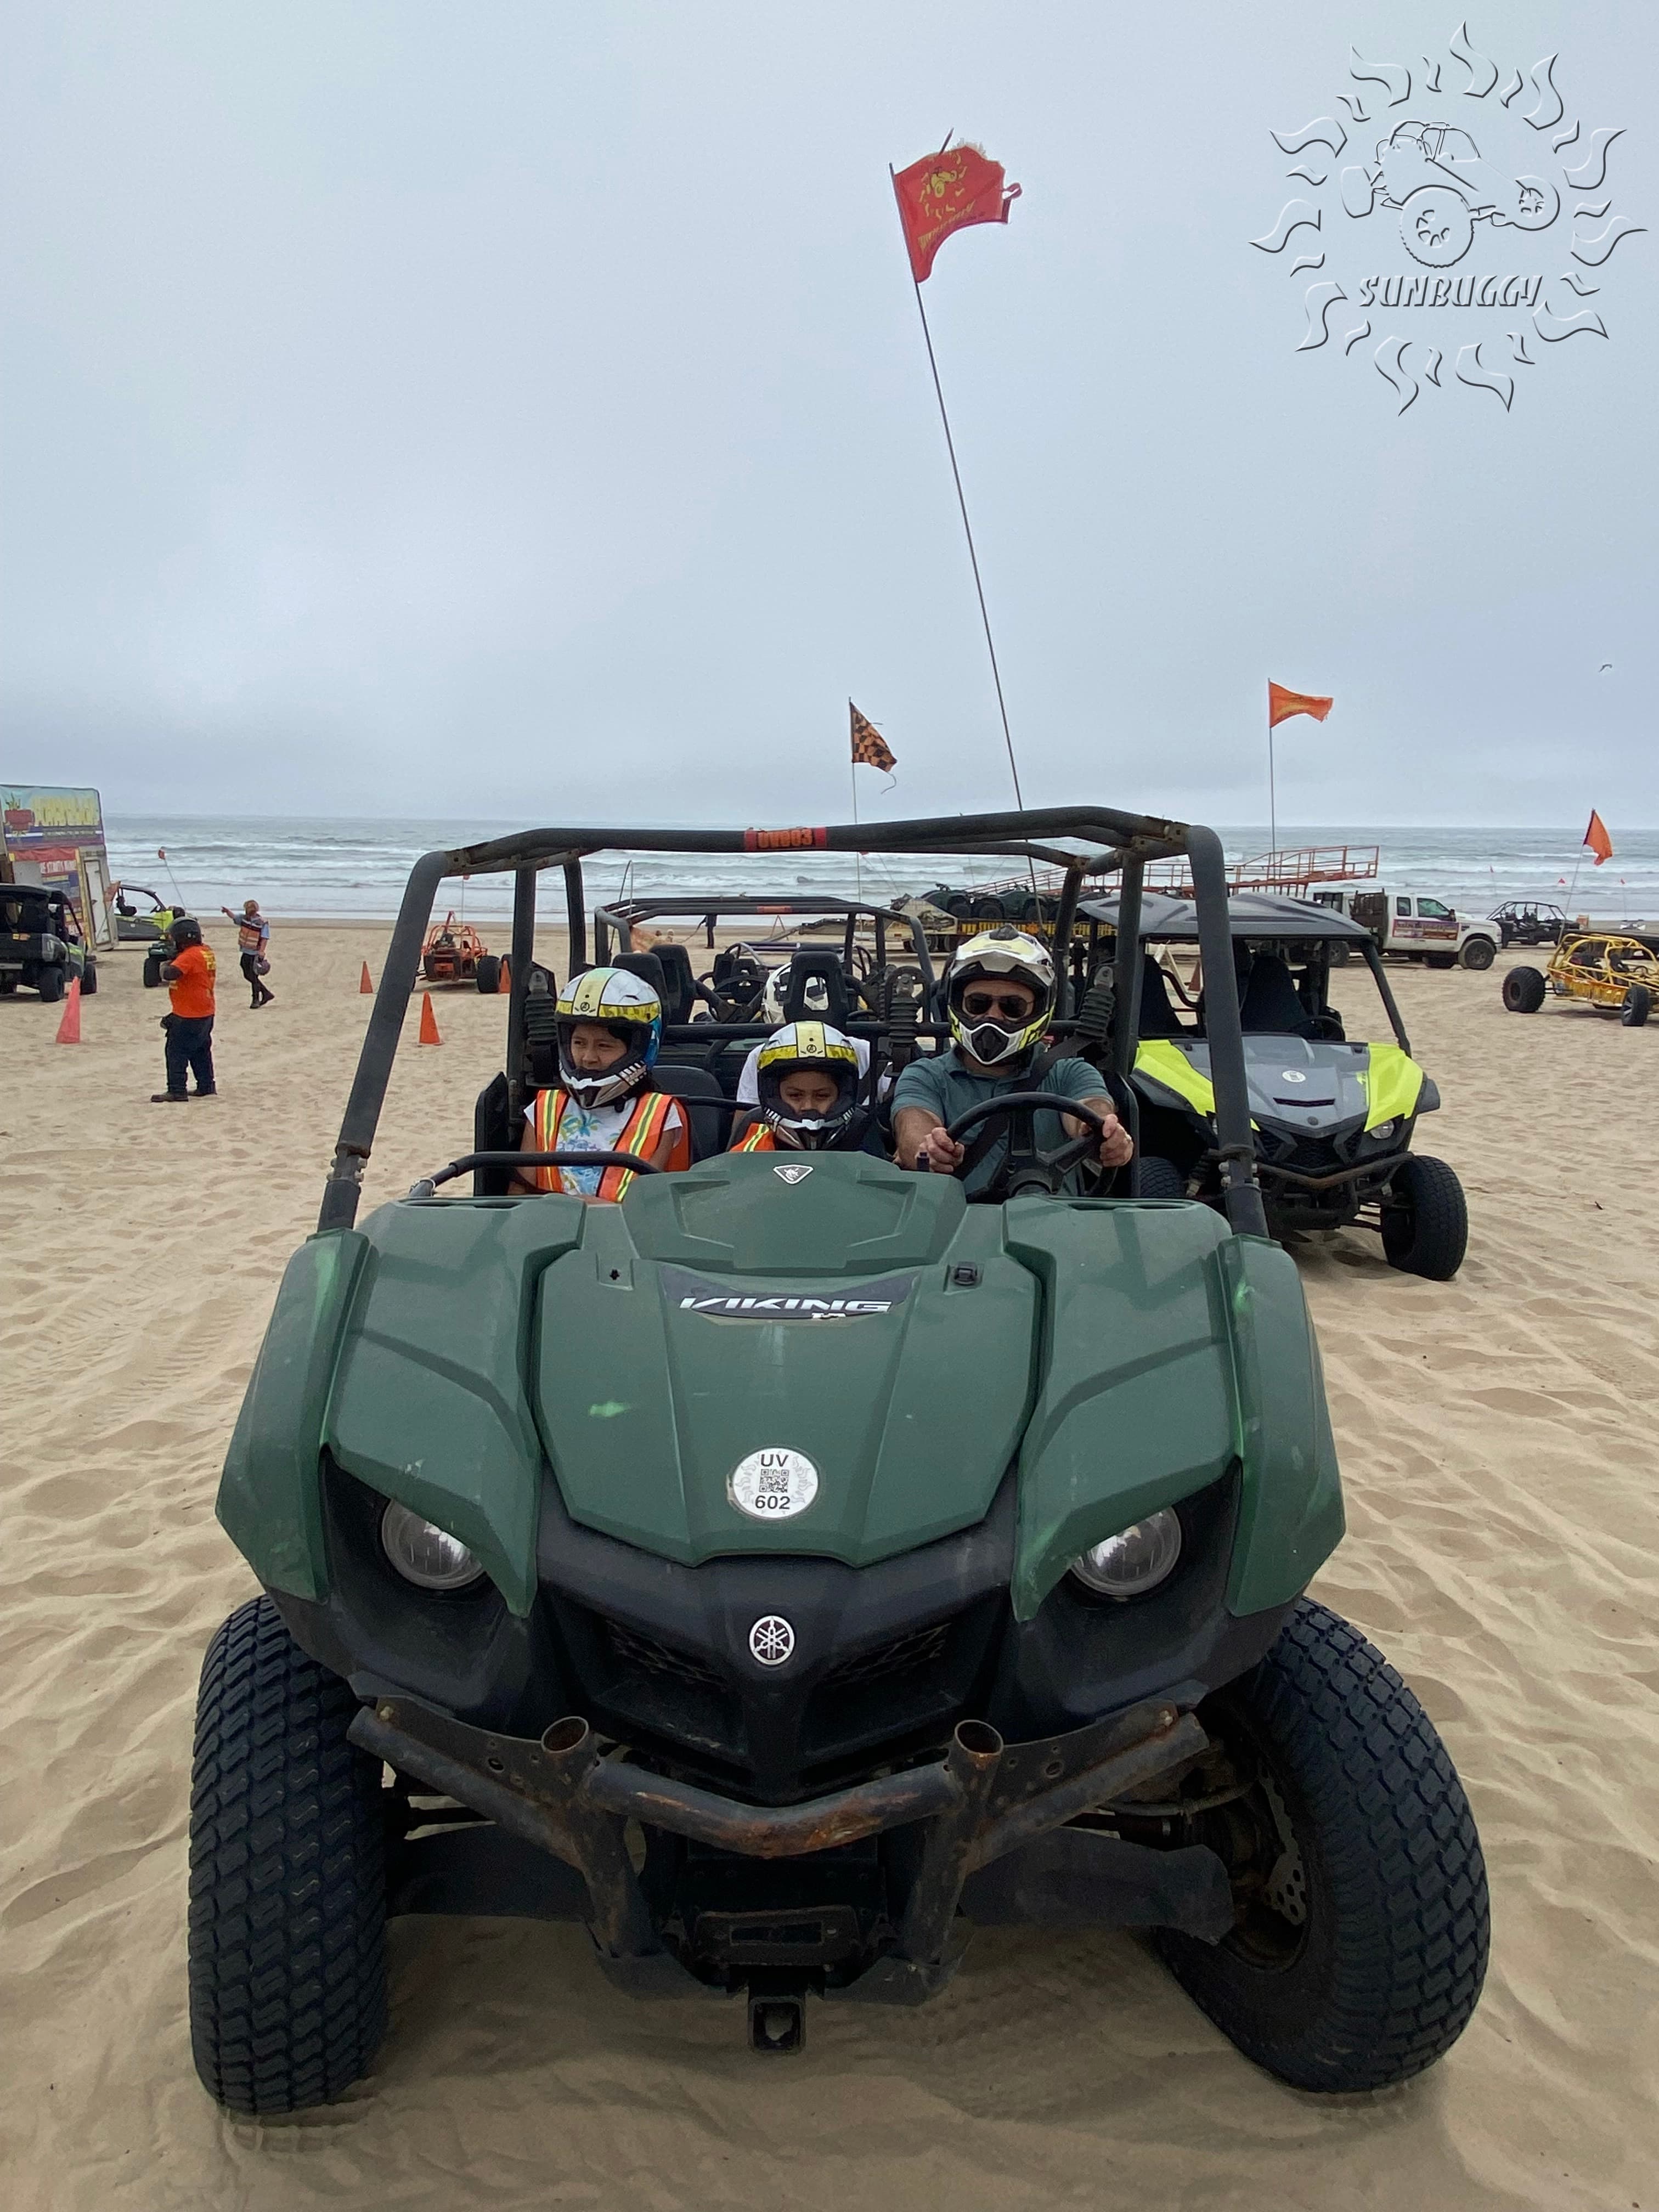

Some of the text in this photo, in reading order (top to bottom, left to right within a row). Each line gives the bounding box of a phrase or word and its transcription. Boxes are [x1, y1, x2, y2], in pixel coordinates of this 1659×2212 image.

[680, 1297, 891, 1312] VIKING
[760, 1454, 789, 1467] UV
[755, 1495, 791, 1510] 602
